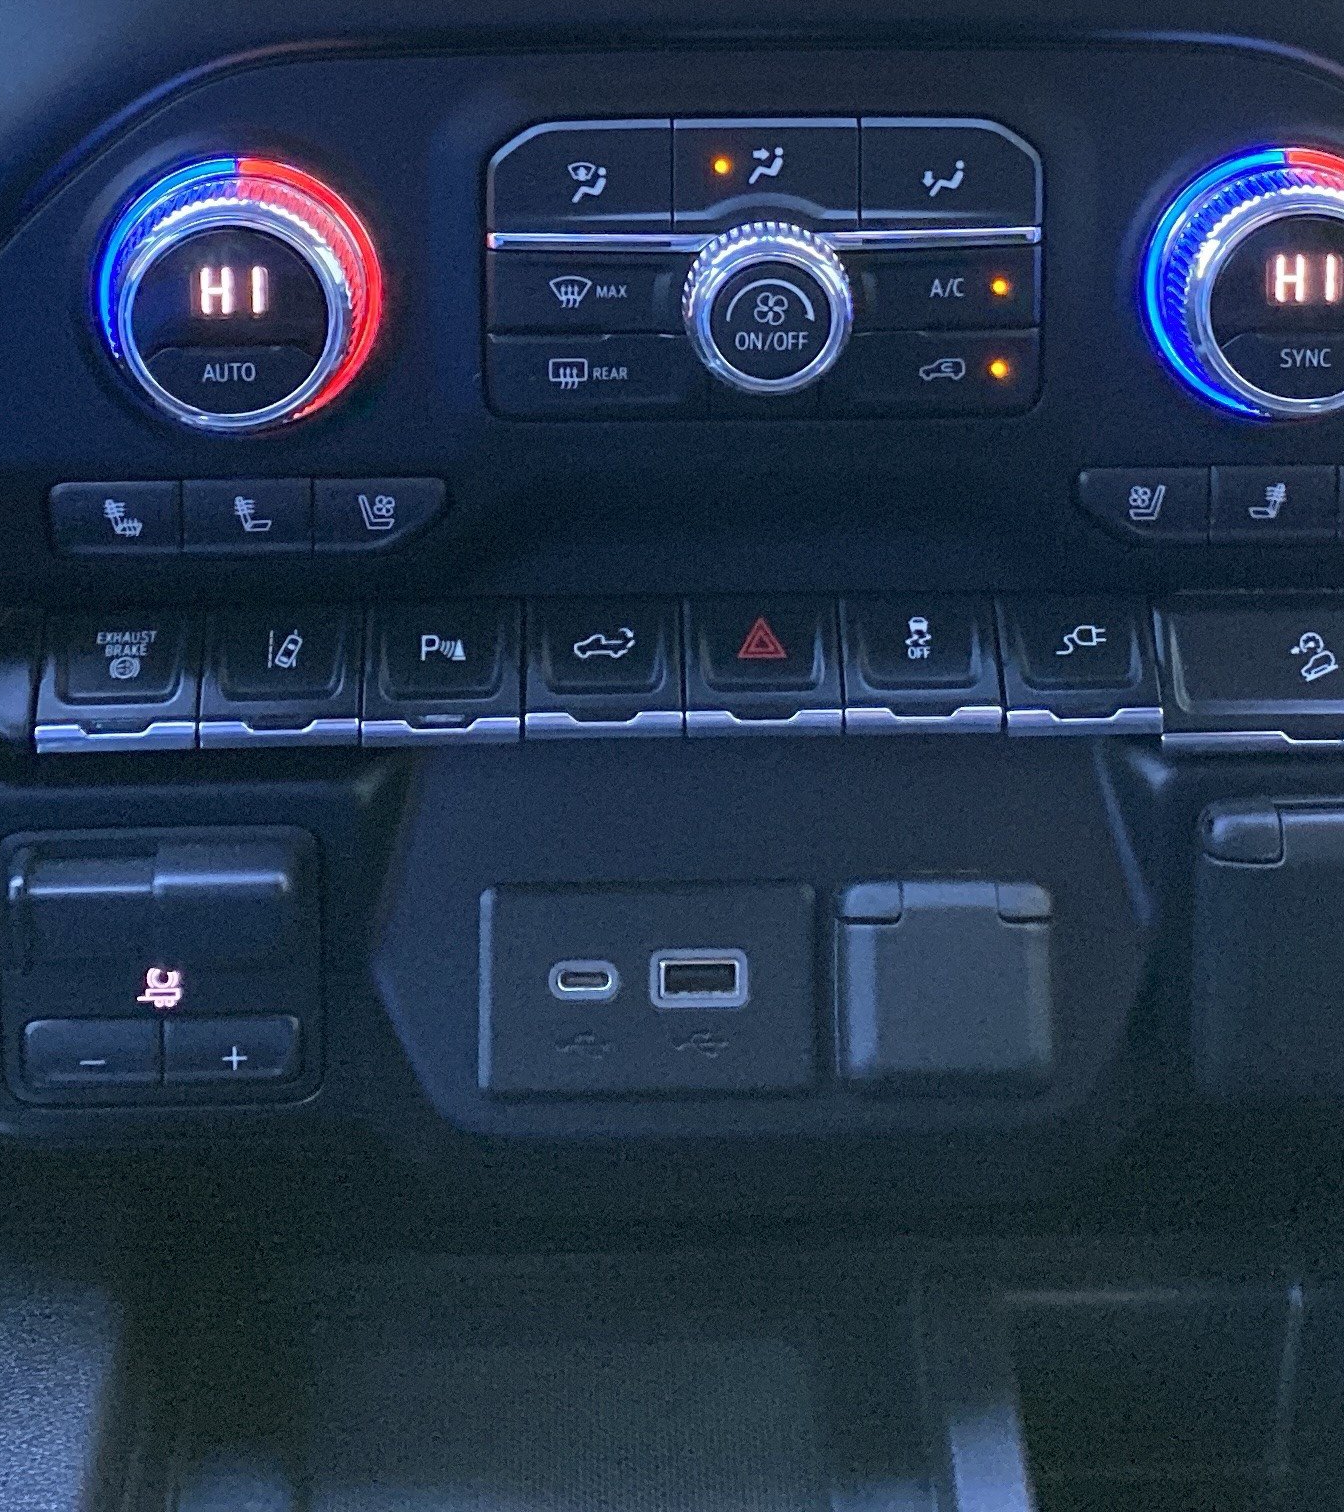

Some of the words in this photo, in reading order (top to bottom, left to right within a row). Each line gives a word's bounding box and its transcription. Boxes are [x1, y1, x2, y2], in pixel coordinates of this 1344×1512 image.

[930, 277, 964, 297] A/C
[1273, 253, 1338, 303] HI
[199, 265, 268, 315] HI
[595, 284, 628, 299] MAX
[734, 330, 809, 352] ON/OFF
[1280, 348, 1332, 368] SYNC
[202, 362, 256, 383] AUTO
[592, 366, 628, 380] REAR
[96, 630, 157, 645] EXHAUST
[105, 643, 147, 657] BRAKE
[907, 646, 931, 659] OFF
